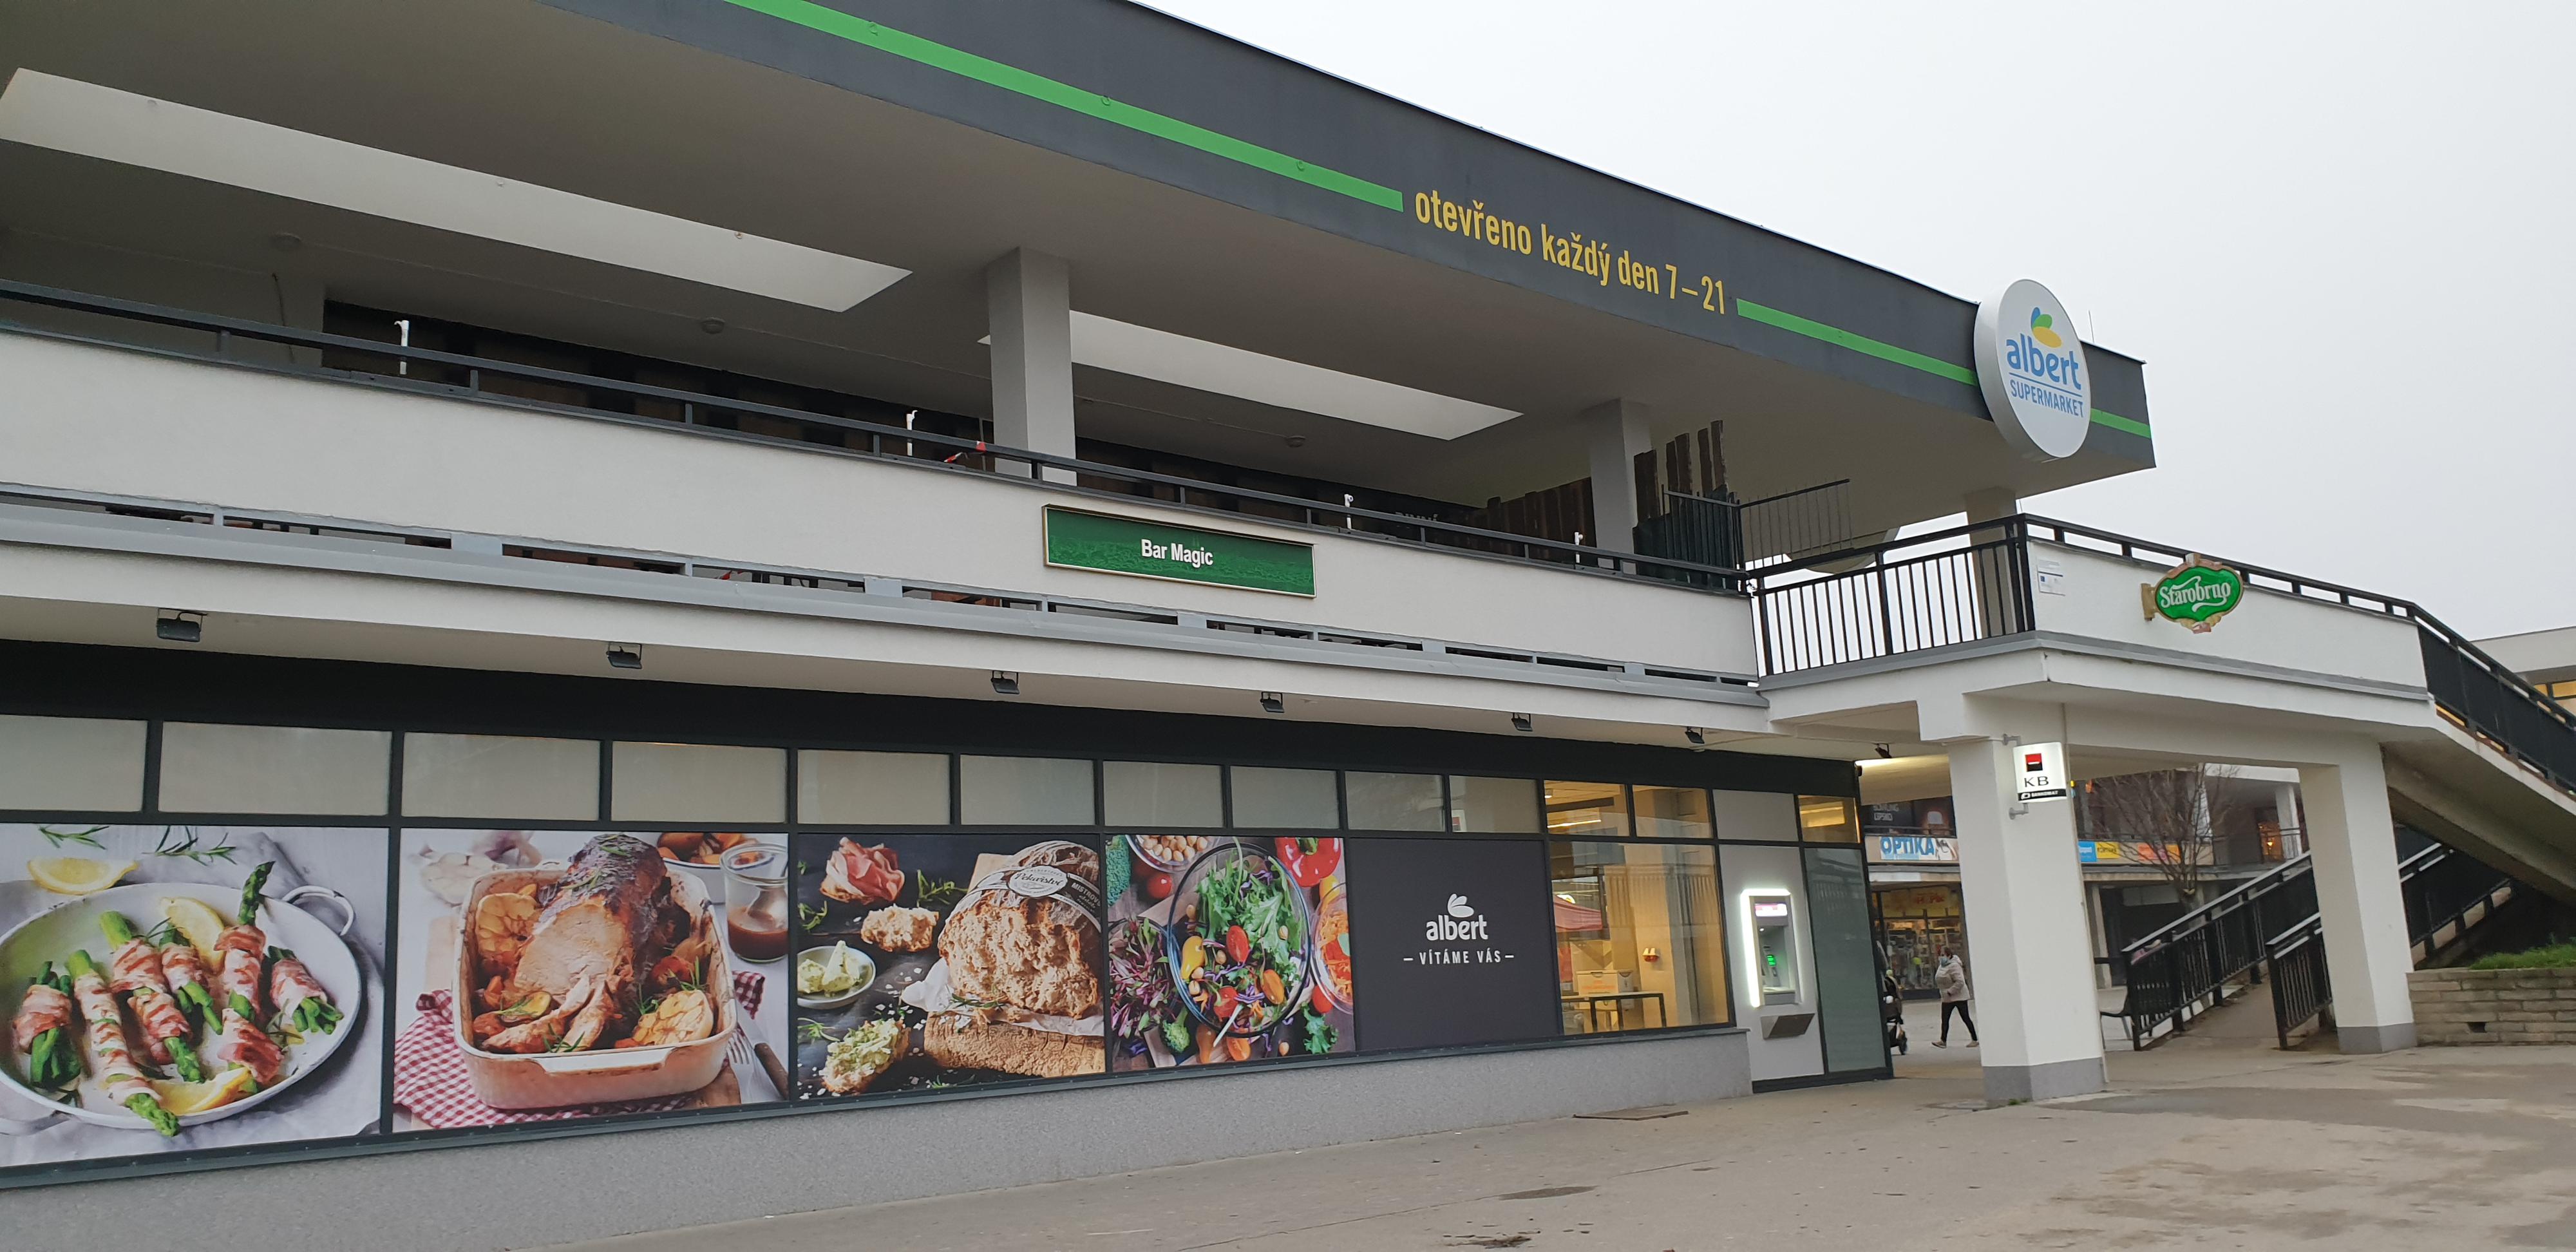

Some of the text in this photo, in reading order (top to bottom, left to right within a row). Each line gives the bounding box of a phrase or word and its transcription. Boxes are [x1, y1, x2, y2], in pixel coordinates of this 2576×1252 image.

[1416, 189, 1532, 256] otevřeno
[1541, 223, 1611, 286] každý
[1618, 251, 1660, 294] den
[2006, 332, 2081, 390] albert
[2009, 379, 2084, 418] SUPERMARKET
[1141, 538, 1214, 567] Bar Magic
[2159, 576, 2231, 612] Starobrno
[2024, 776, 2049, 788] KB
[1880, 837, 1935, 855] OPTIKA
[1426, 914, 1489, 941] albert
[1419, 947, 1501, 965] VÍTÁME VÁS
